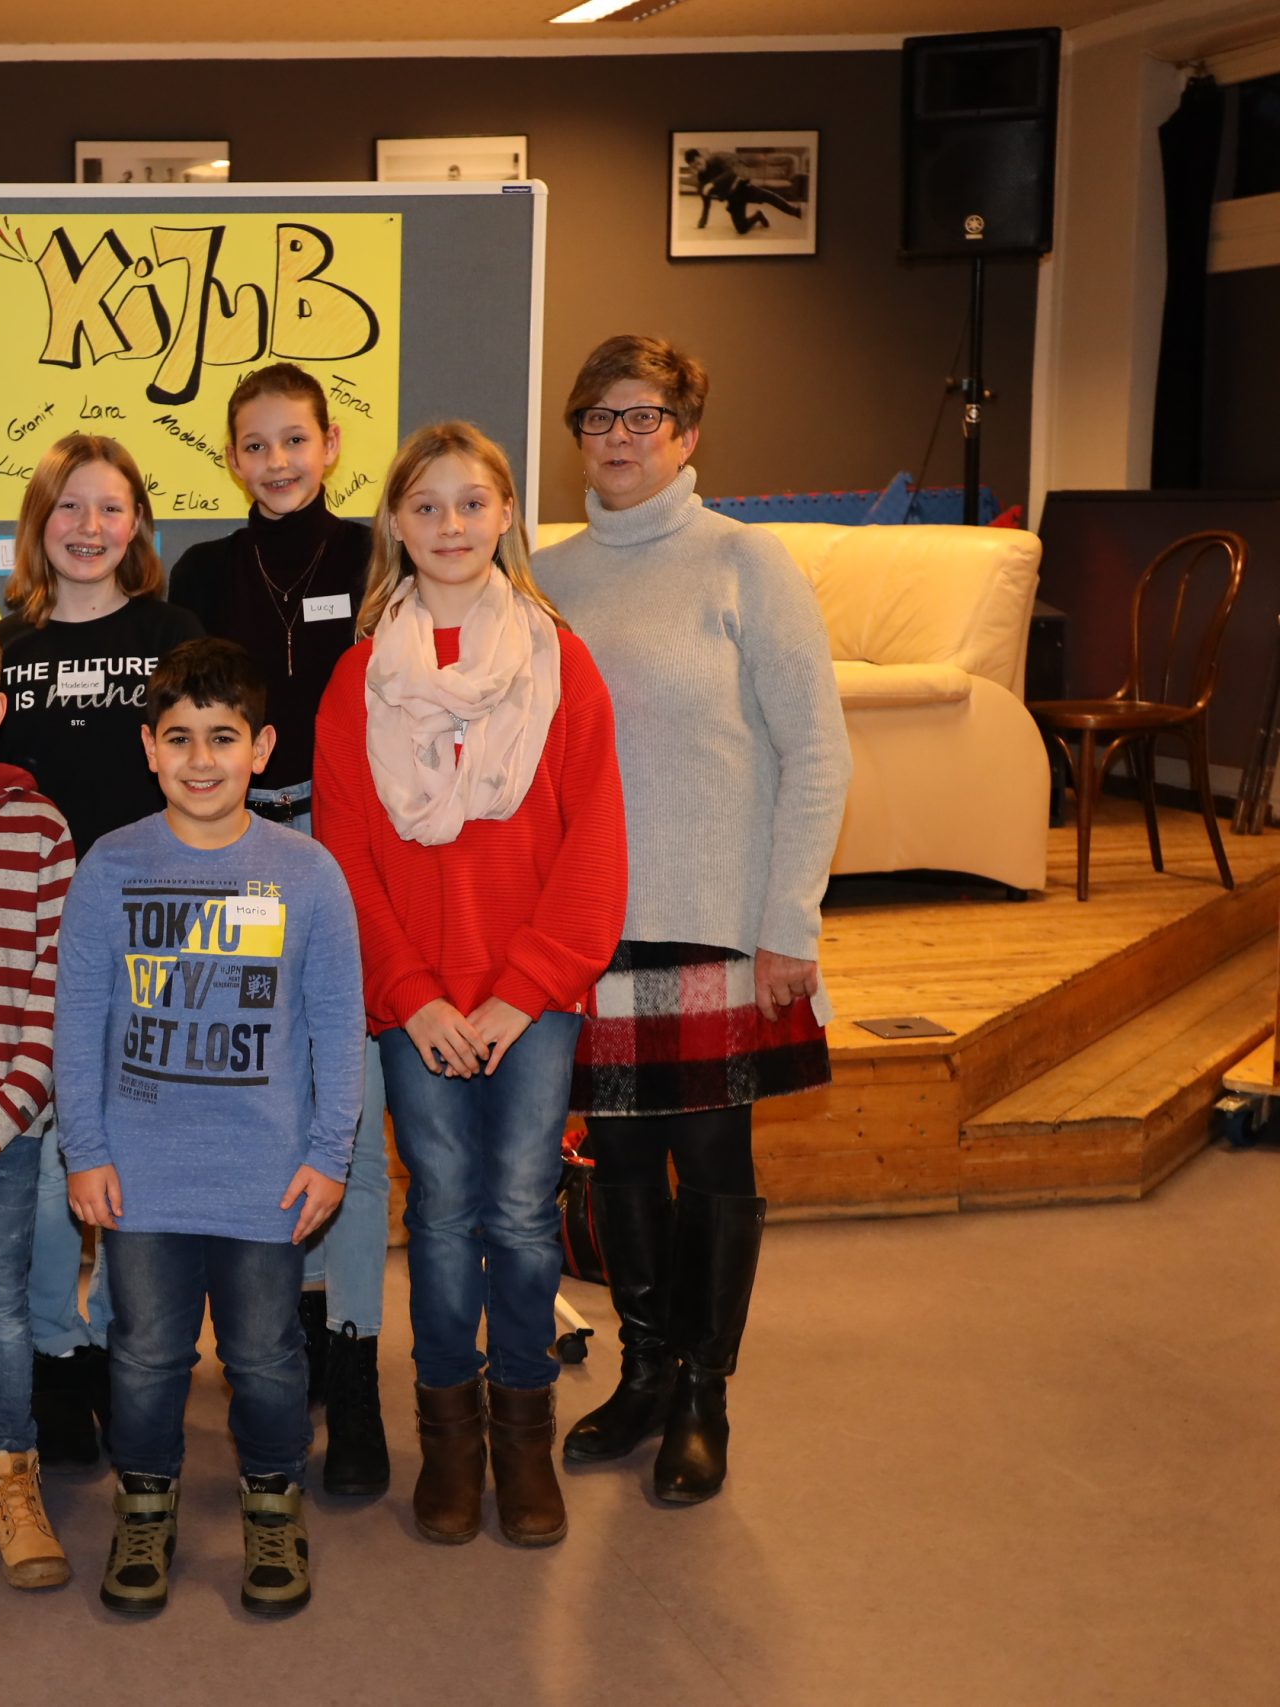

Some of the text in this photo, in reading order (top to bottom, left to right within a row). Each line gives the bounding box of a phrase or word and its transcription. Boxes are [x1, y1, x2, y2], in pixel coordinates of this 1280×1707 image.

[79, 395, 127, 419] Lara
[330, 374, 374, 419] Fiona
[7, 402, 55, 441] Granit
[153, 414, 226, 469] Madeleine
[172, 490, 220, 511] Elias
[310, 604, 335, 615] Lucy
[3, 662, 50, 686] THE
[61, 681, 100, 689] Madeleine
[15, 690, 36, 712] IS
[71, 719, 86, 727] STC
[247, 880, 282, 898] 日本
[122, 901, 242, 953] TOKYO
[123, 1013, 272, 1073] GET LOST
